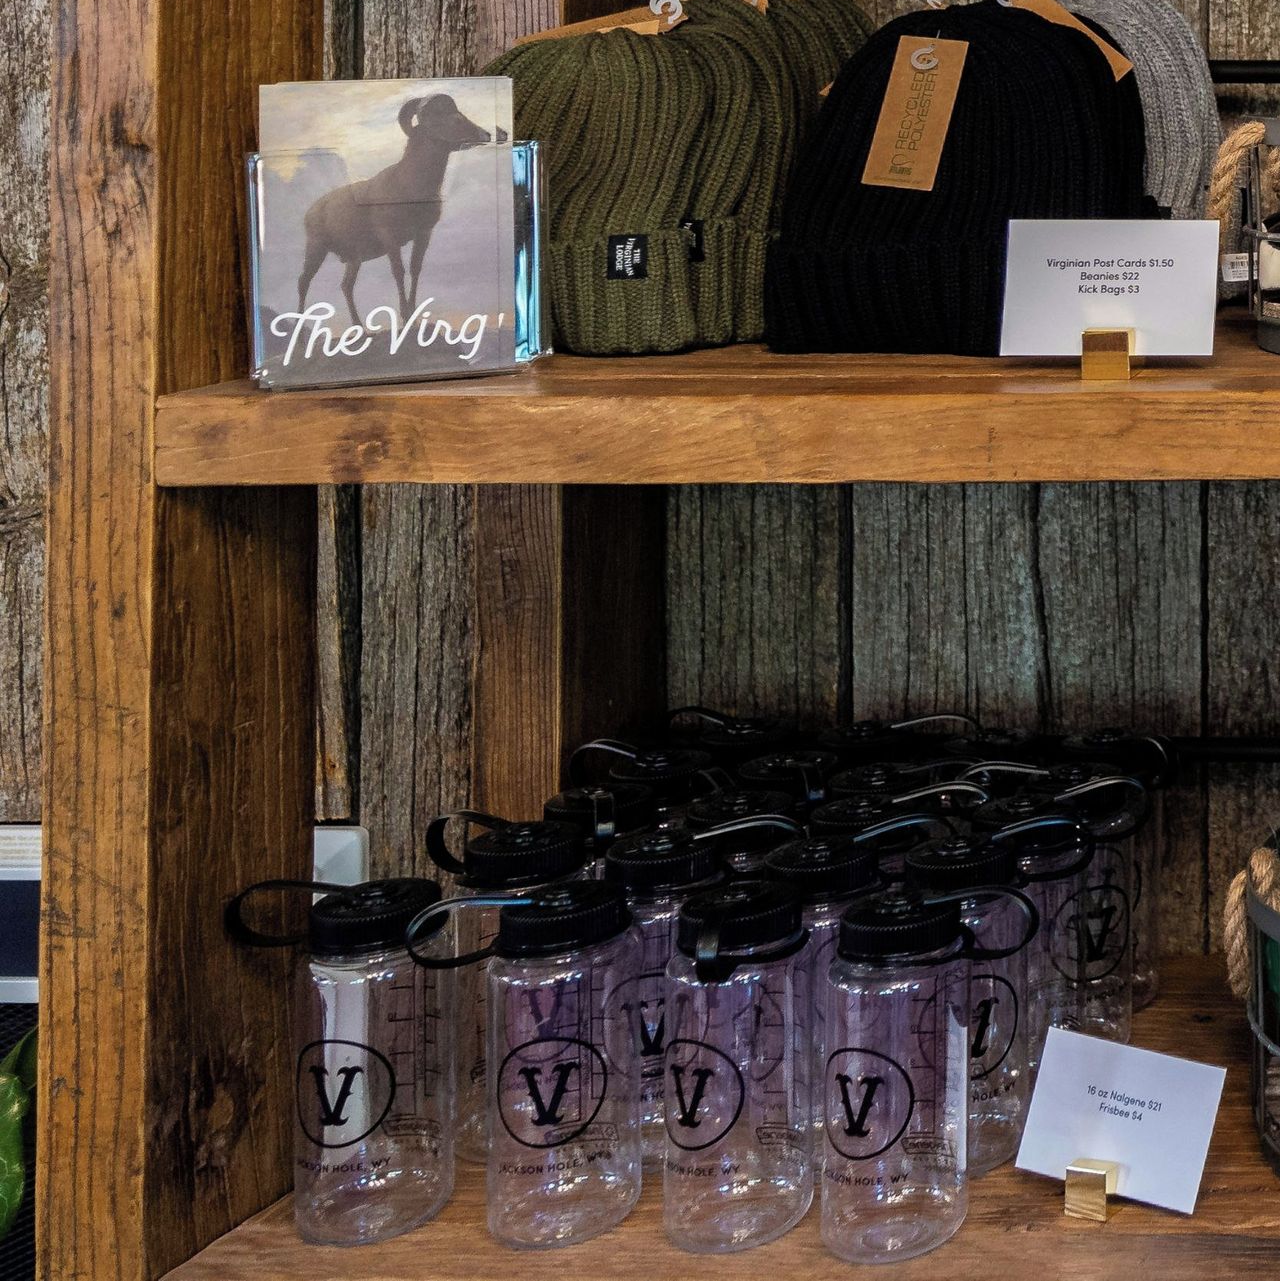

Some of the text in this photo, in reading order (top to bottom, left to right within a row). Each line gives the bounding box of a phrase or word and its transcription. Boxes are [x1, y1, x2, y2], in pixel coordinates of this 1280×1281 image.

[894, 71, 926, 149] RECYCLED
[1047, 258, 1174, 270] Virginian Post Cards $1.50
[1080, 271, 1140, 281] Beanies $22
[1078, 285, 1140, 296] Kick Bags $3
[270, 301, 375, 369] The
[1087, 1085, 1162, 1112] 16 oz Nalgene $21
[1099, 1102, 1143, 1121] Frisbee $4
